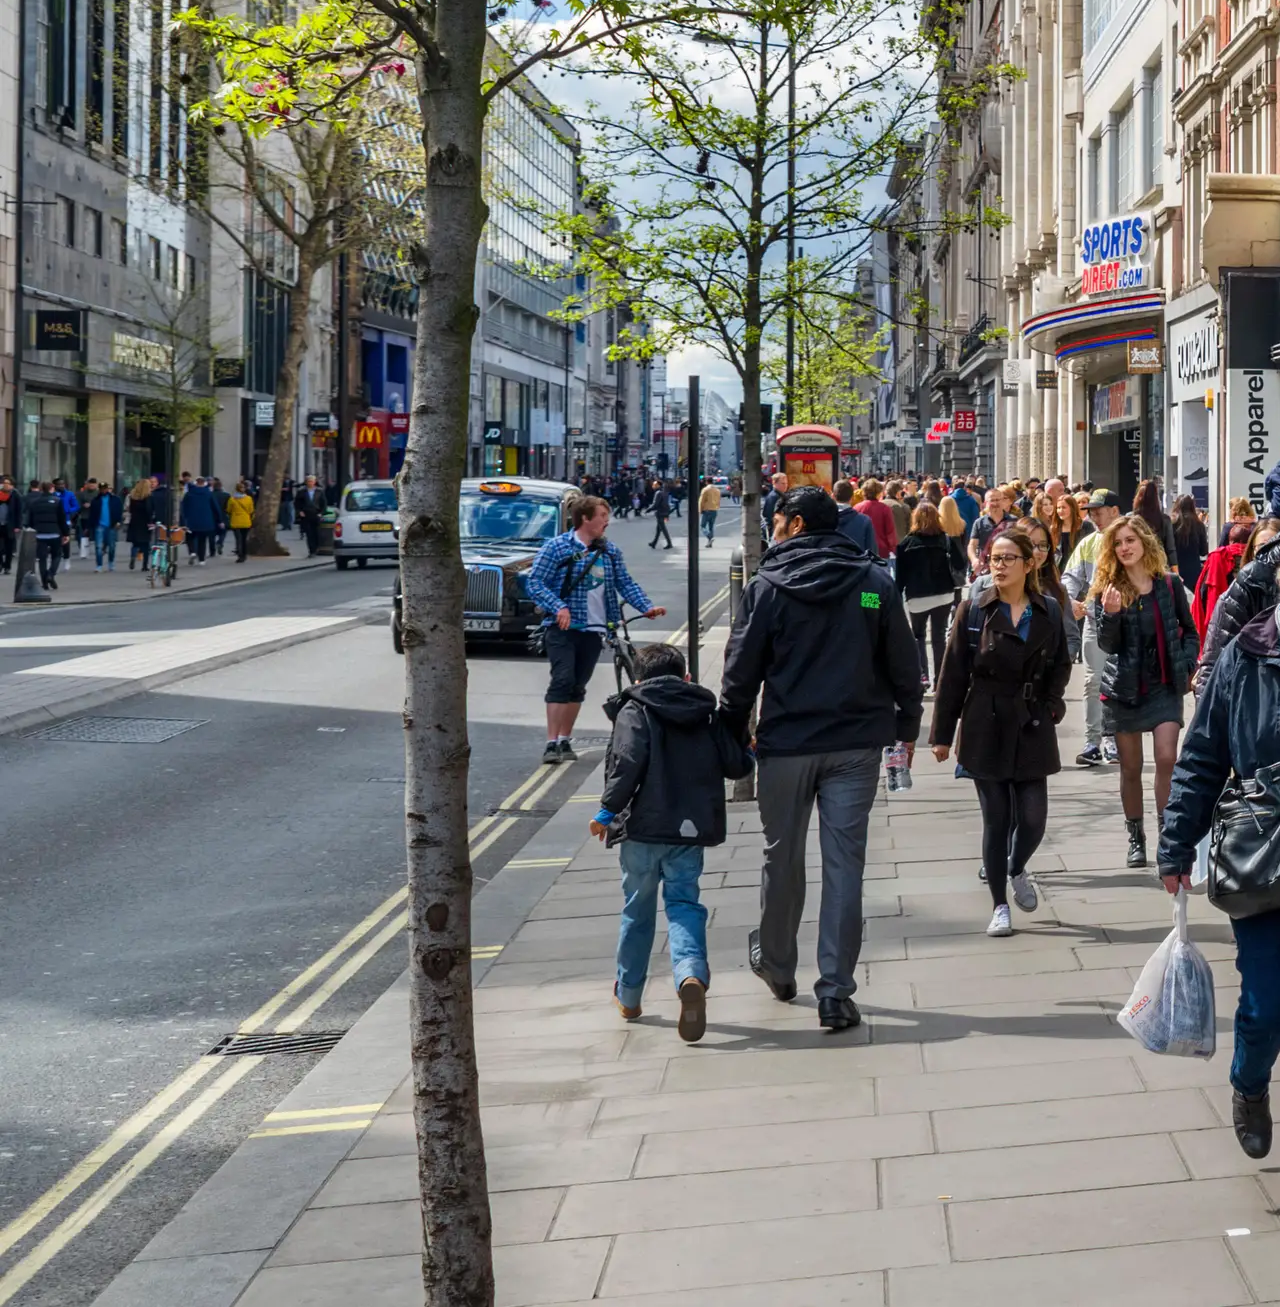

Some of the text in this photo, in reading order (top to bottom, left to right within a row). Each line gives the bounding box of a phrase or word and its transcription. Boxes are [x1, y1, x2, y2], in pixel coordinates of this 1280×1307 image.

[1082, 217, 1143, 263] SPORTS
[1082, 262, 1143, 295] DIRECT.COM
[44, 322, 73, 334] M&S
[485, 428, 500, 438] JD
[1243, 370, 1269, 475] Apparel
[477, 620, 495, 629] YLX
[1129, 995, 1149, 1016] TESCO
